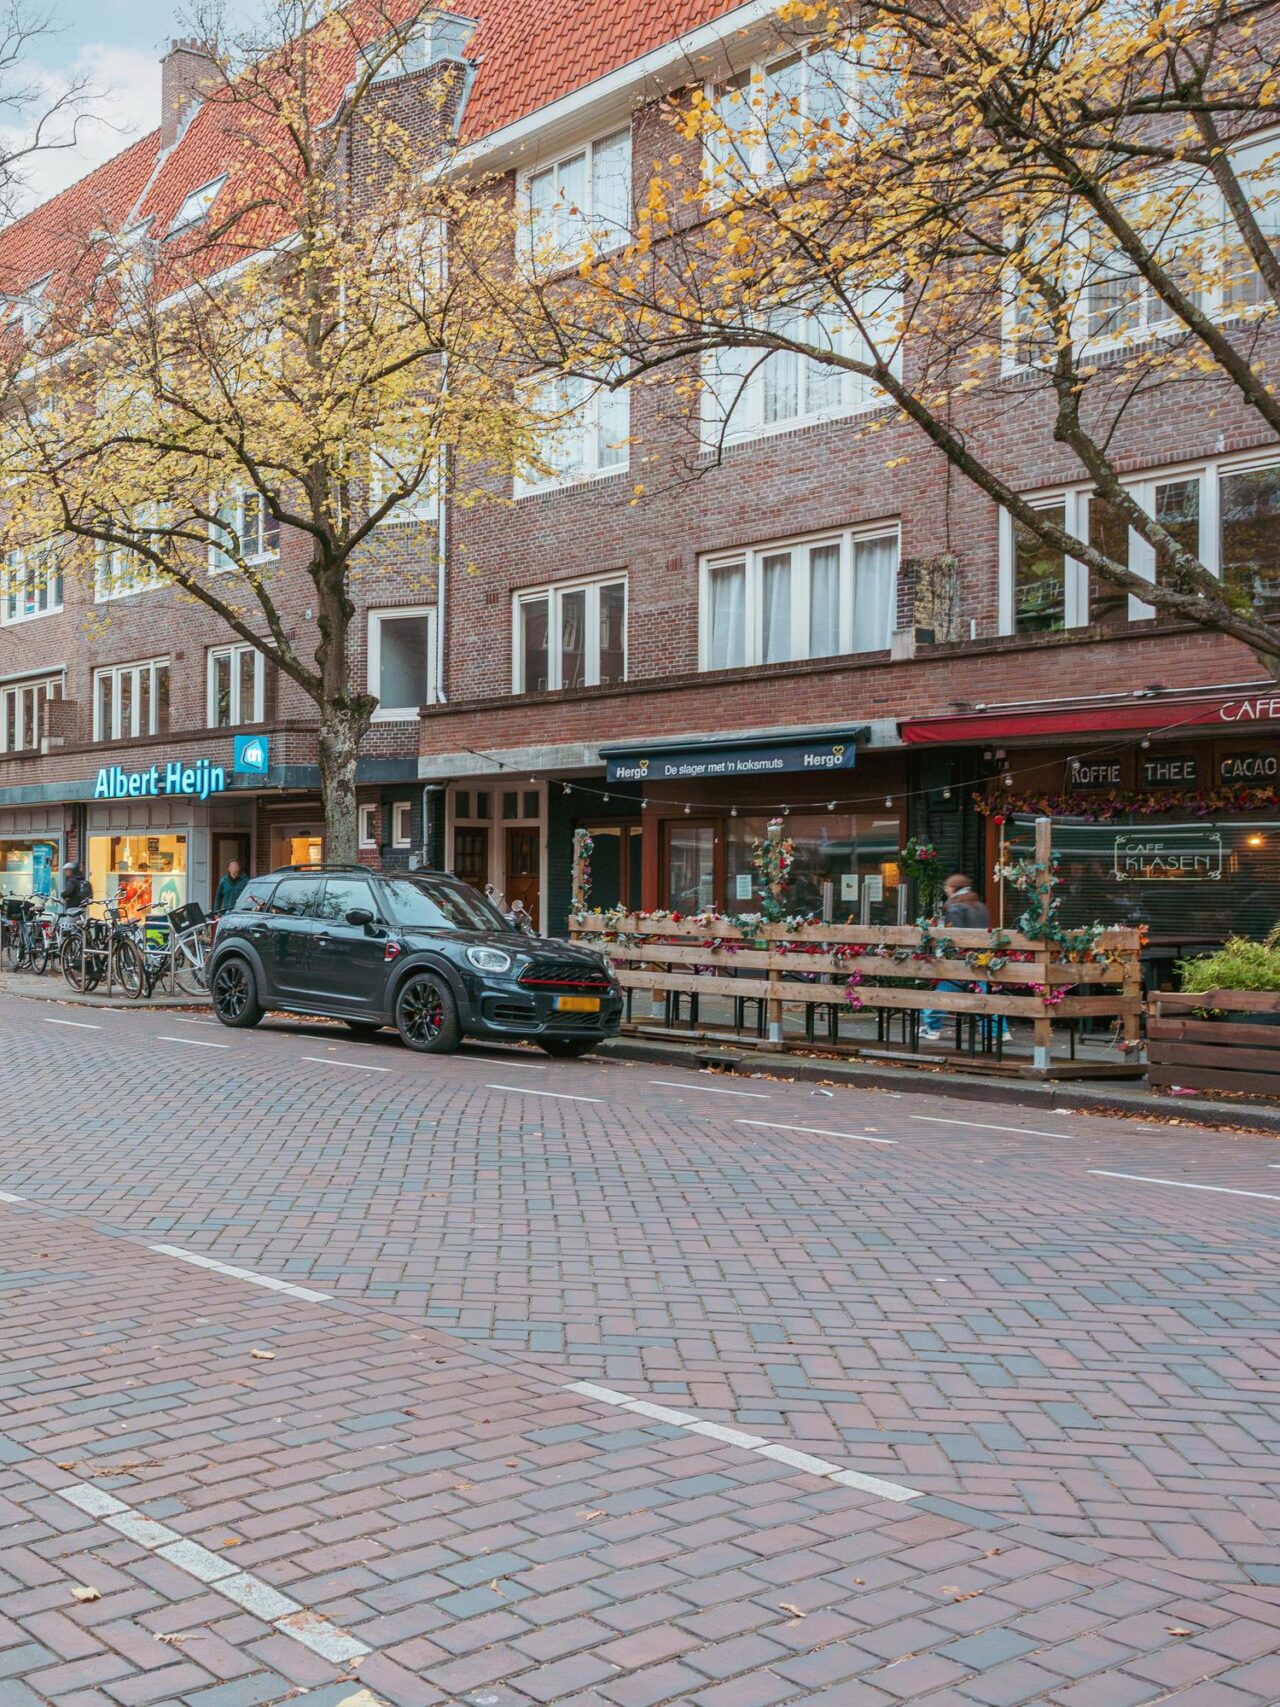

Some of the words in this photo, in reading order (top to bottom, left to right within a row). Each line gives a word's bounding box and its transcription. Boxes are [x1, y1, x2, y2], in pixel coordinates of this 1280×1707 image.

[616, 767, 648, 779] Hergo
[664, 765, 677, 775] De
[679, 764, 705, 776] slager
[708, 762, 725, 772] met
[736, 758, 783, 771] koksmuts
[803, 753, 843, 767] Hergo
[1071, 764, 1121, 783] KOFFIE
[1144, 761, 1196, 780] THEE
[1220, 757, 1277, 777] CACAO
[94, 765, 159, 799] Albert
[165, 760, 225, 800] Heijn
[1125, 843, 1164, 854] CAFE
[1126, 855, 1210, 870] KLASEN
